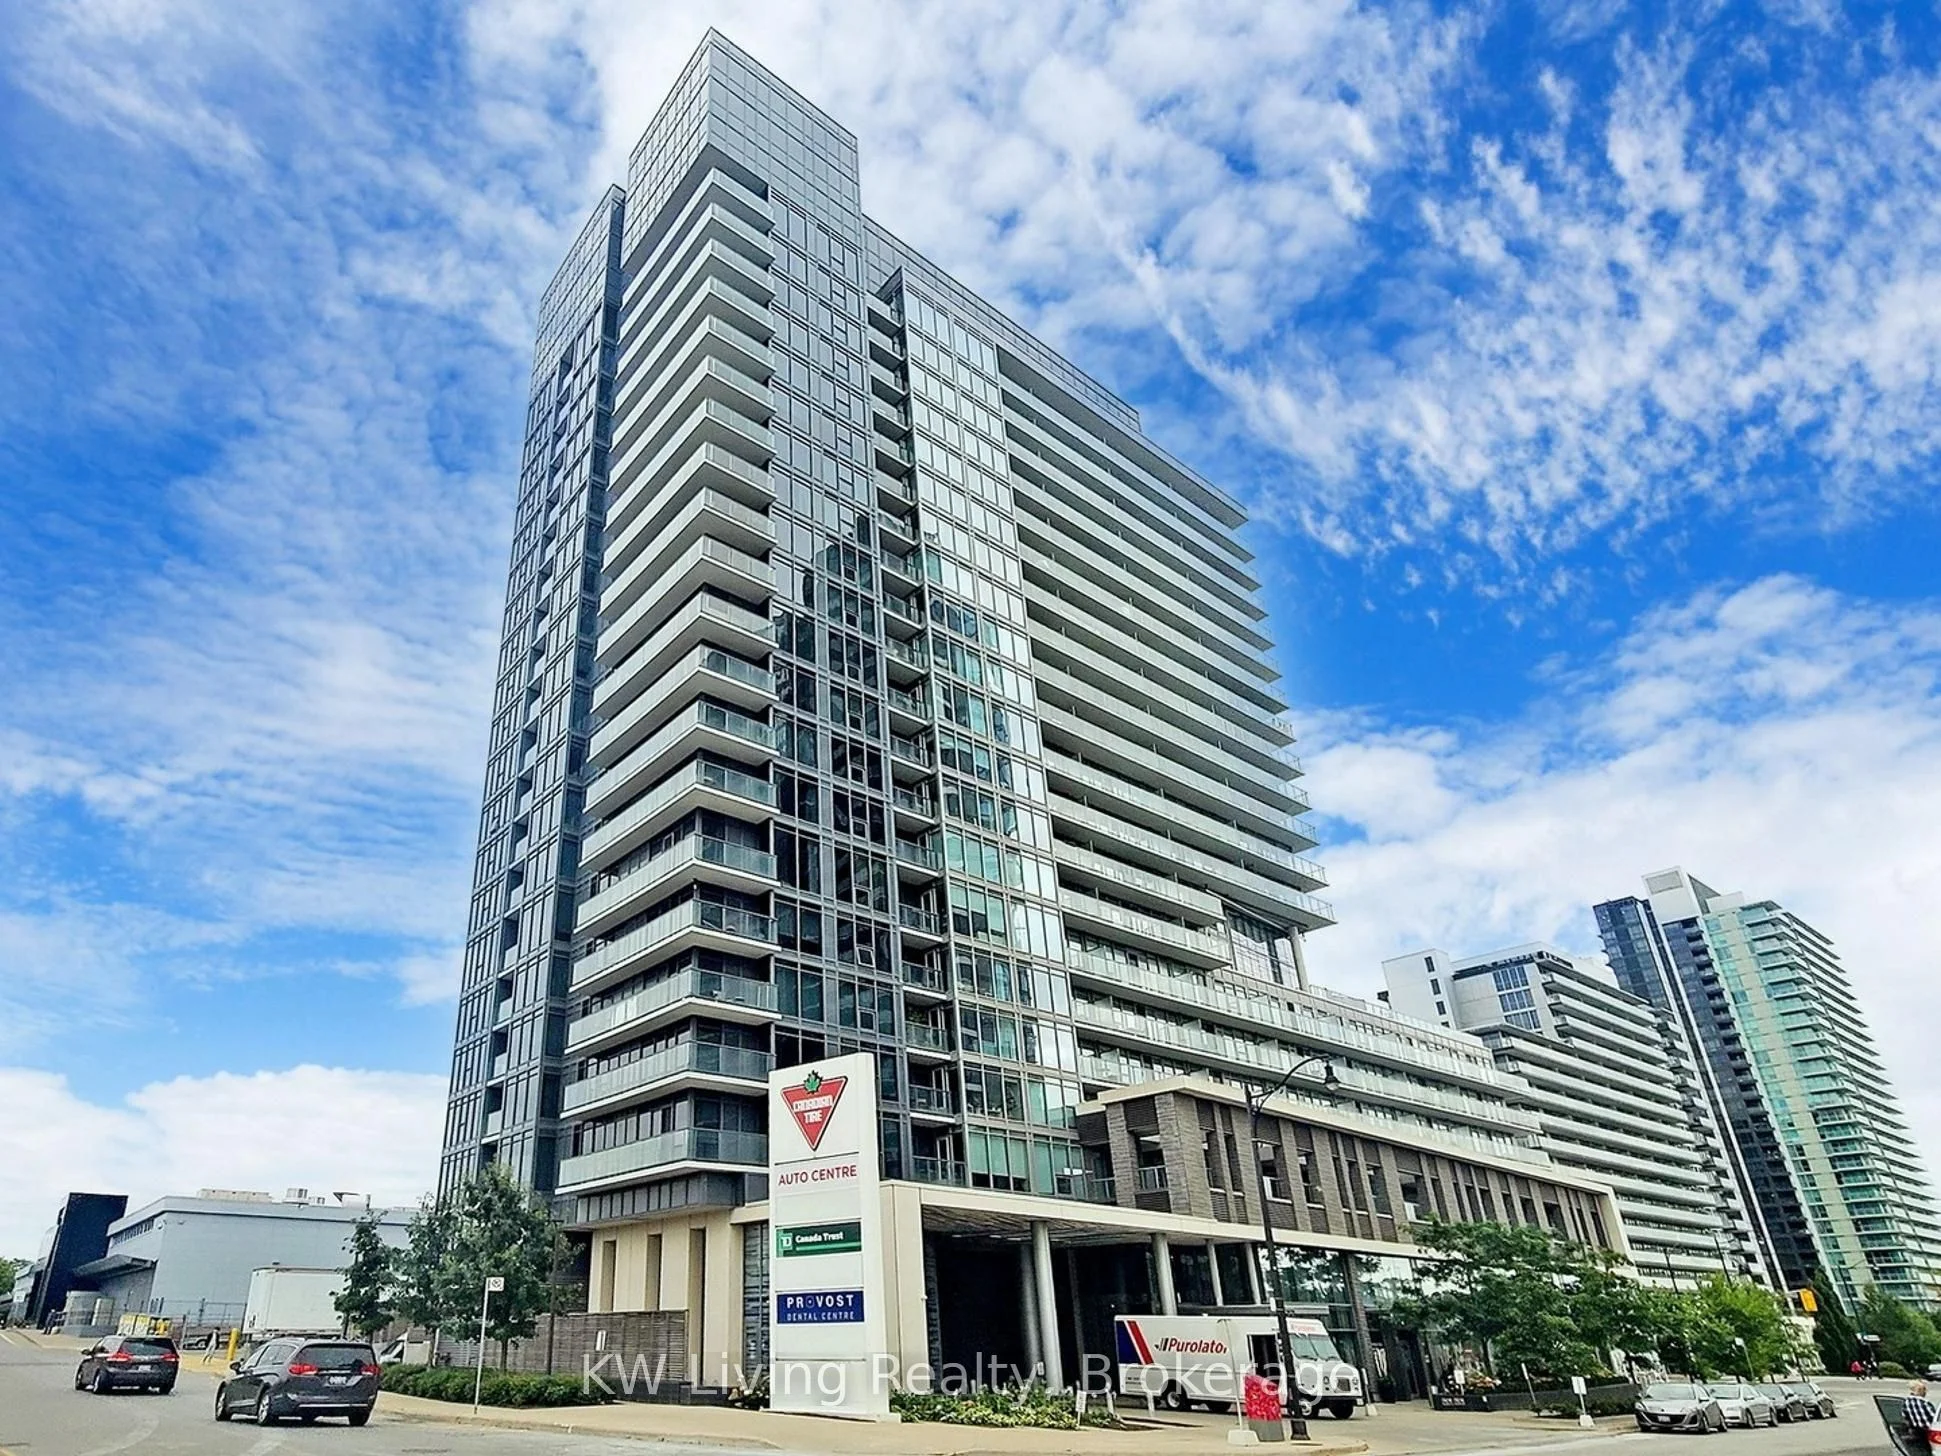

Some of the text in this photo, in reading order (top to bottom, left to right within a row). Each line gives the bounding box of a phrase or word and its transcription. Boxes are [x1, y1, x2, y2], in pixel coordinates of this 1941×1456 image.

[778, 1165, 857, 1186] AUTO CENTRE
[822, 1231, 843, 1241] Trust
[787, 1294, 854, 1308] PROVOST
[787, 1311, 854, 1321] DENTAL CENTRE
